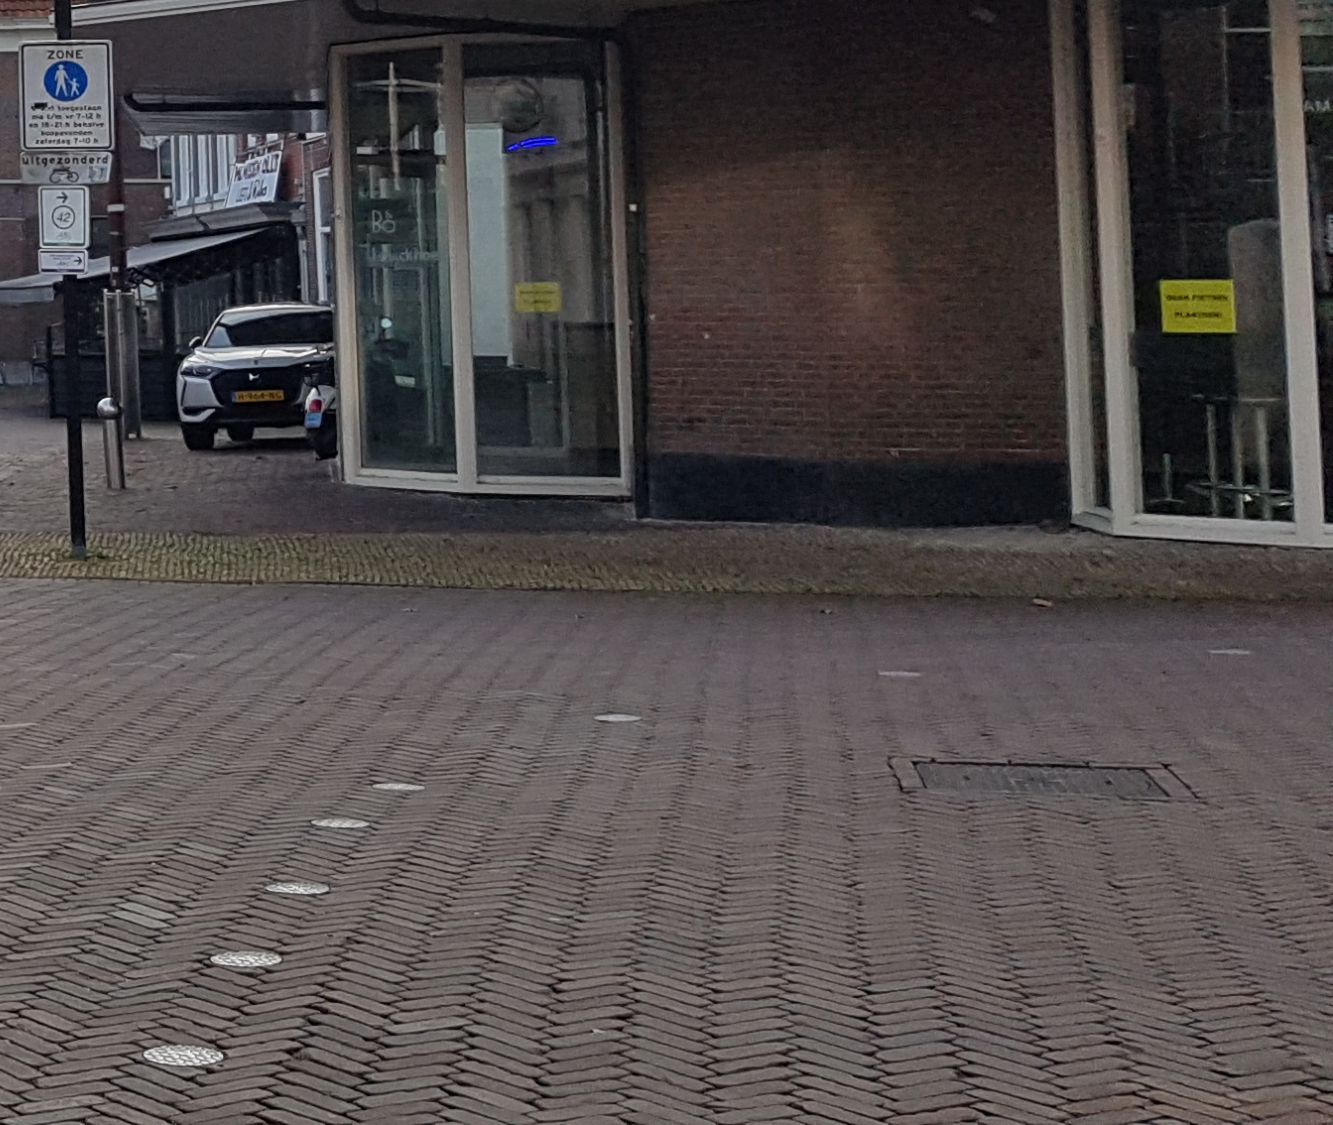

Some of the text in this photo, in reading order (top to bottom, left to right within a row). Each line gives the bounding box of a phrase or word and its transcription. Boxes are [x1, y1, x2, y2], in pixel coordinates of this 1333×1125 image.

[47, 49, 84, 60] ZONE
[22, 155, 109, 167] uitgezonderd
[56, 211, 72, 223] 42
